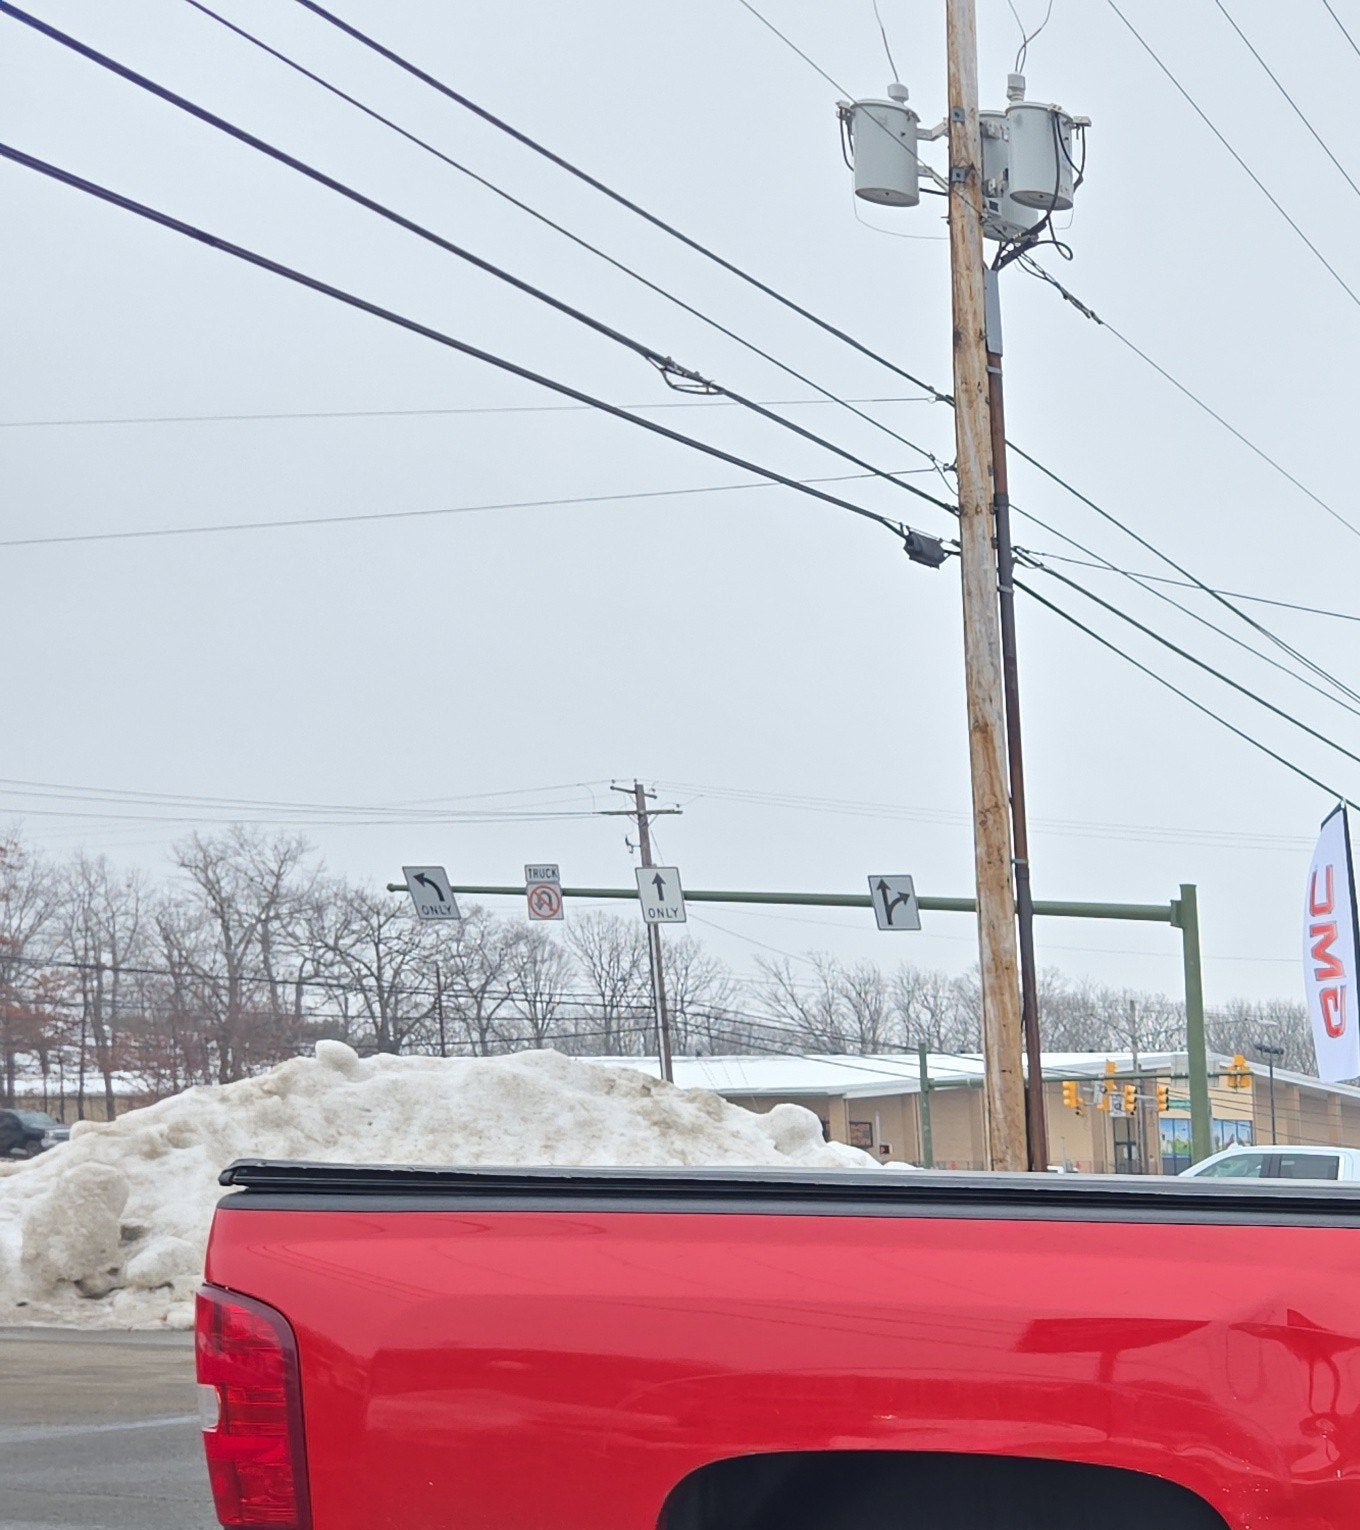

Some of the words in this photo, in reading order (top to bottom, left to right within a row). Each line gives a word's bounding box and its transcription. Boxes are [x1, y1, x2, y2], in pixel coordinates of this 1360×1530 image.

[529, 868, 558, 879] TRUCK
[421, 904, 452, 916] ONLY
[648, 907, 679, 918] ONLY
